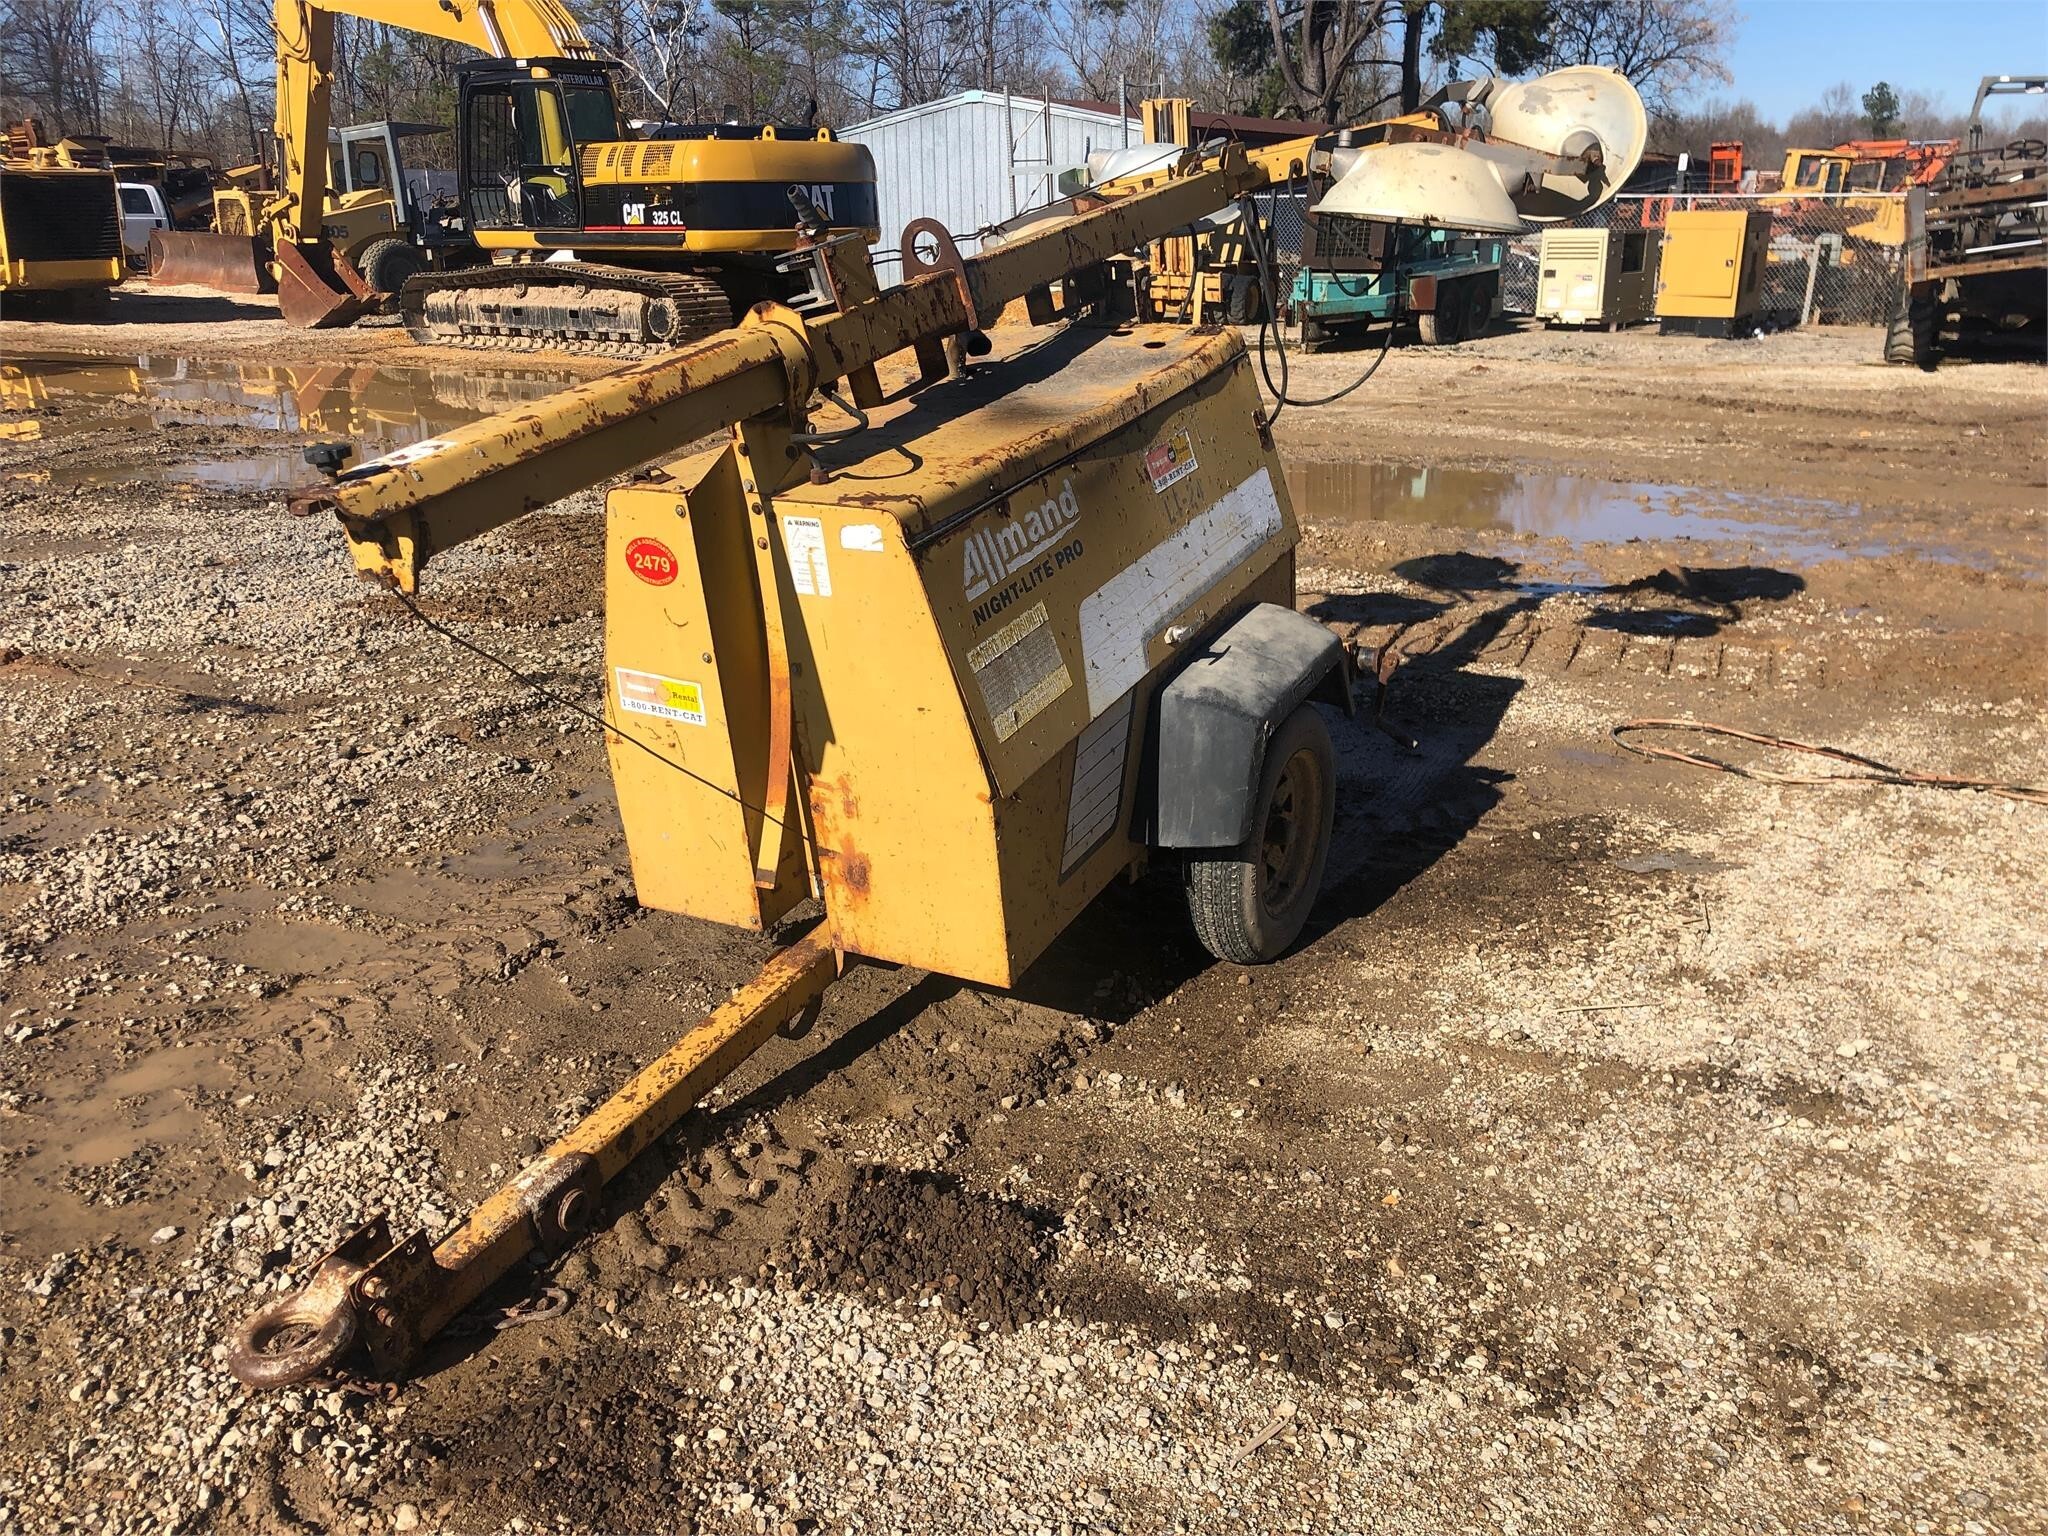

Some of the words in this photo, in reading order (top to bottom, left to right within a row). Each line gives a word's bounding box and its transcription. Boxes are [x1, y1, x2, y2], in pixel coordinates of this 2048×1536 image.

[557, 73, 605, 86] CATERPILLAR
[622, 203, 646, 225] CAT
[652, 210, 669, 225] 325
[670, 210, 684, 225] CL
[794, 520, 820, 528] WARNING
[963, 478, 1080, 602] Allmand
[633, 552, 671, 573] 2479
[972, 559, 1054, 627] NIGHT-LITE
[1054, 538, 1084, 570] PRO
[672, 691, 698, 704] Rental
[622, 698, 703, 722] 1-800-RENT-CAT
